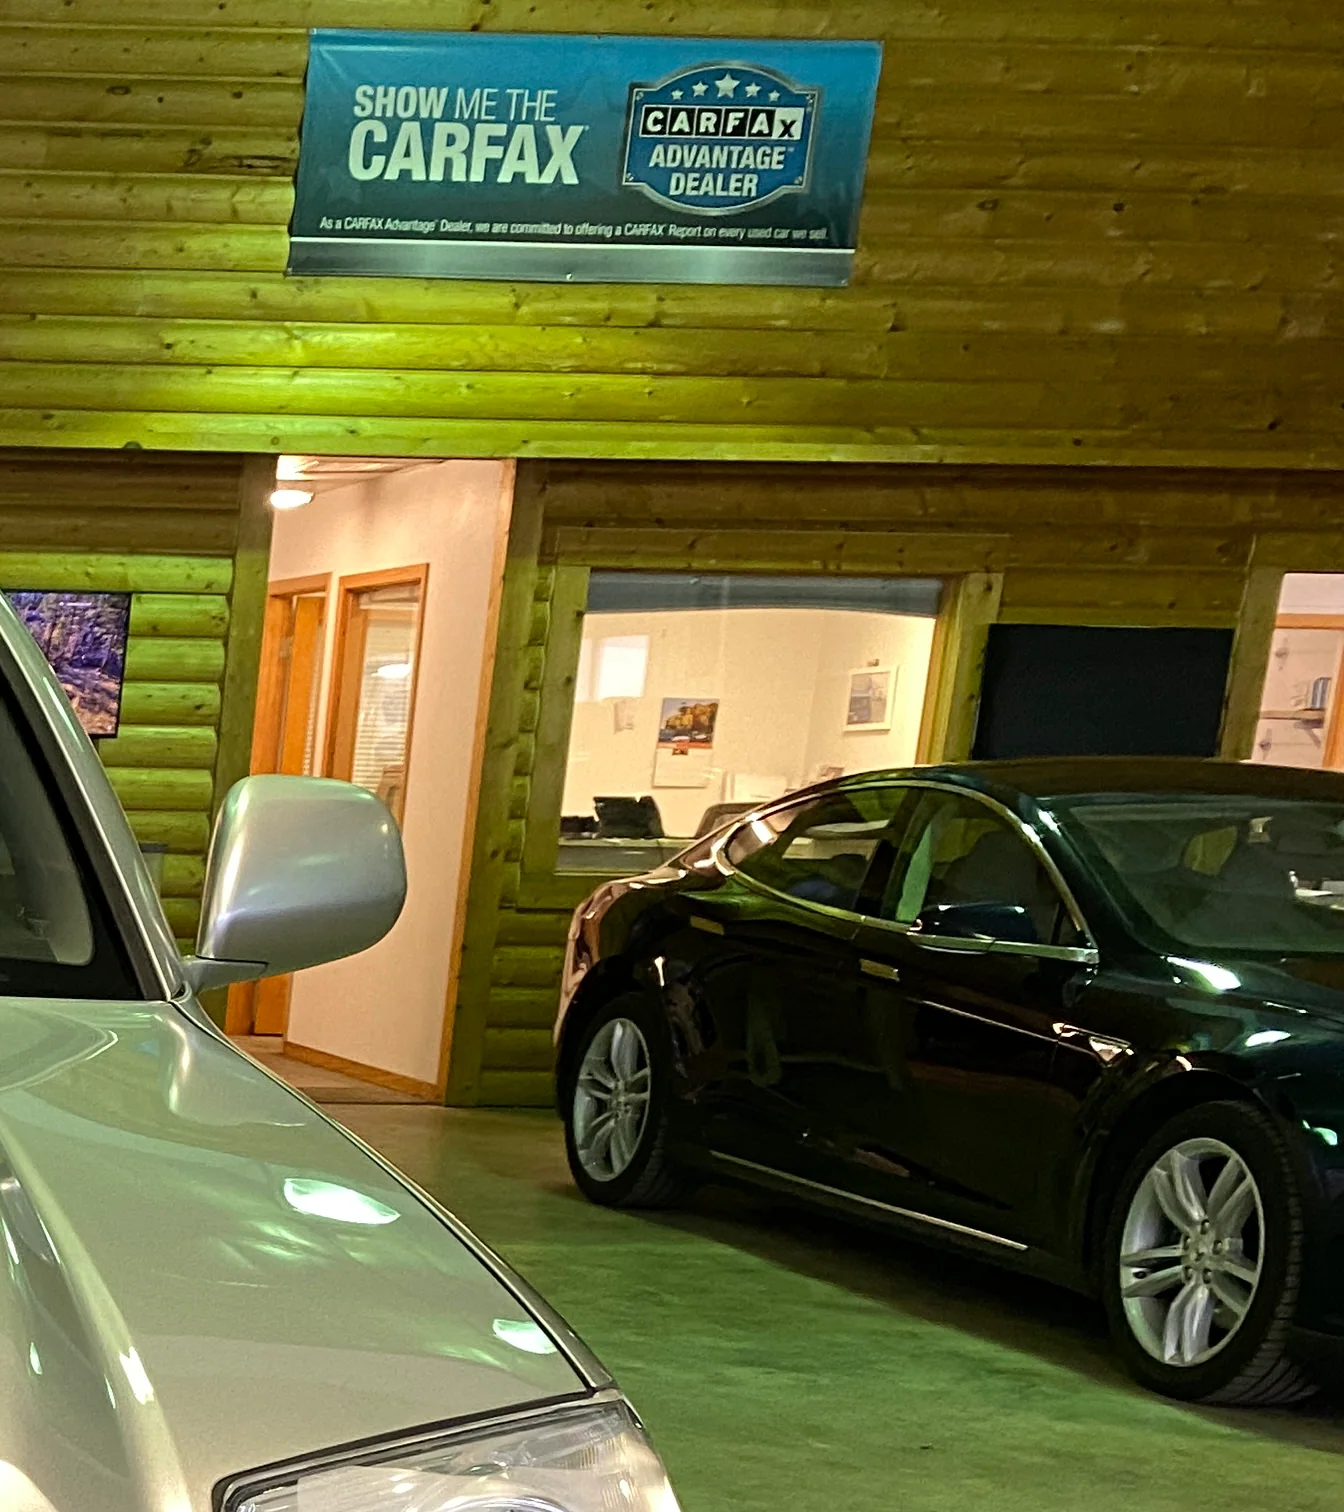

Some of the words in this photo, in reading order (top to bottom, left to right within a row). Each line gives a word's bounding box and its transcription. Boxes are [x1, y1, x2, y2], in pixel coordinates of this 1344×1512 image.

[353, 84, 449, 119] SHOW
[454, 86, 500, 120] ME
[505, 88, 559, 122] THE
[644, 110, 797, 138] CARFAX
[348, 119, 586, 185] CARFAX
[648, 144, 787, 170] ADVANTAGE
[668, 172, 759, 197] DEALER
[319, 216, 333, 230] As
[334, 219, 342, 230] a
[343, 217, 384, 231] CARFAX
[384, 217, 436, 234] Advantage
[475, 223, 490, 233] we
[491, 223, 508, 233] are
[510, 221, 562, 235] committed
[563, 222, 574, 235] to
[575, 222, 613, 239] offering
[615, 225, 622, 236] a
[624, 223, 666, 237] CARFAX
[668, 224, 702, 240] Report
[704, 227, 717, 238] on
[718, 226, 745, 241] every
[747, 225, 772, 239] used
[774, 228, 790, 239] car
[792, 228, 807, 239] we
